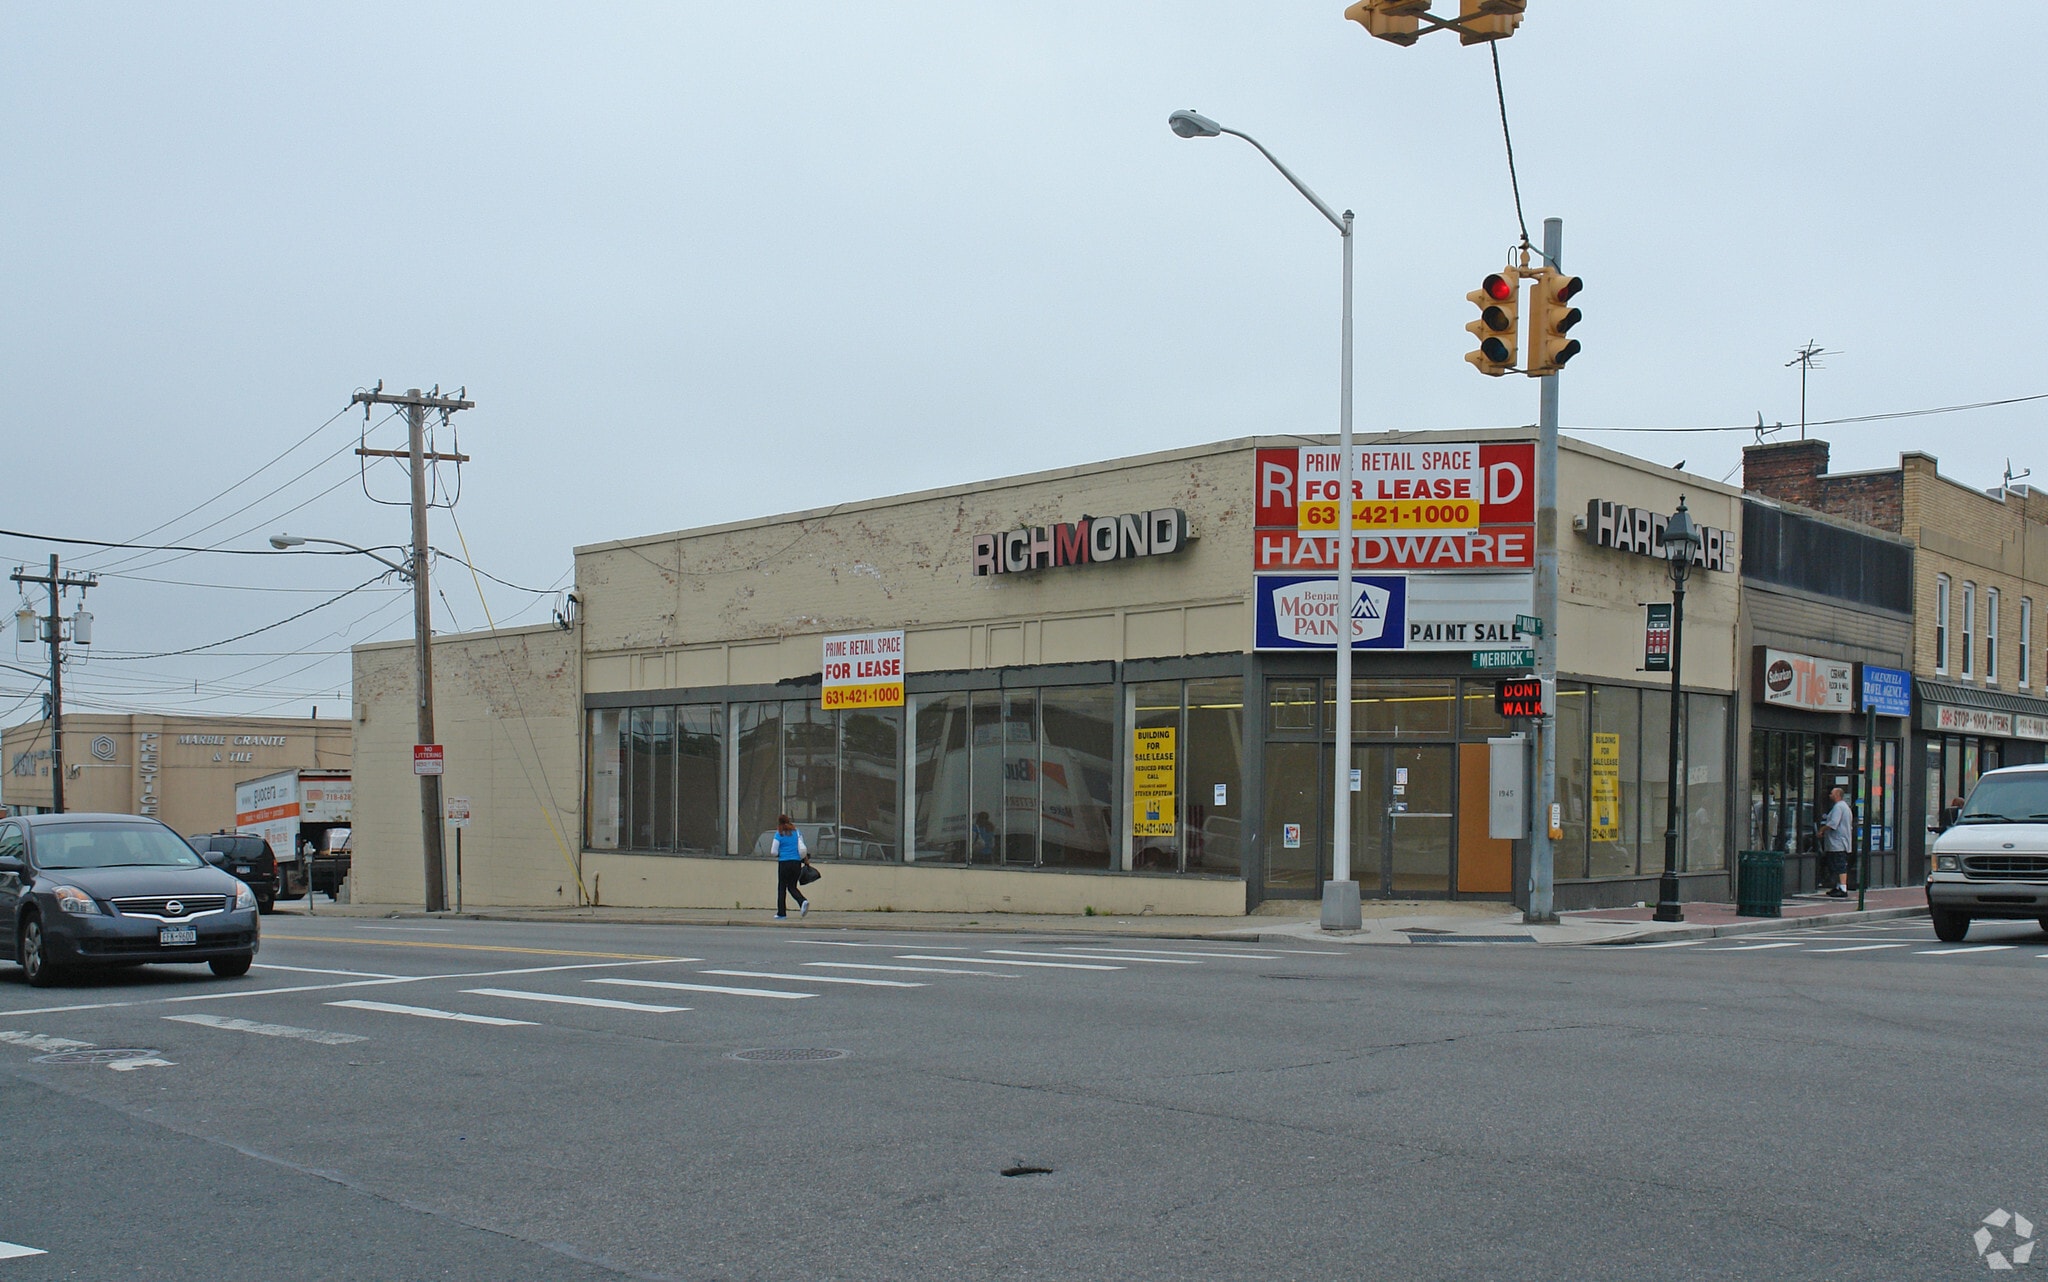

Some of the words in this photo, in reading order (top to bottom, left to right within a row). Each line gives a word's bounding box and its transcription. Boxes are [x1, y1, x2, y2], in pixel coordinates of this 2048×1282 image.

[1306, 453, 1354, 472] PRIM
[1362, 452, 1415, 471] RETAIL
[1422, 451, 1471, 470] SPACE
[1306, 480, 1363, 500] FOR
[1378, 478, 1470, 499] LEASE
[1307, 505, 1470, 525] 63-421-1000
[973, 508, 1182, 576] RICHMOND
[1596, 499, 1735, 573] HARDARE
[1281, 597, 1340, 616] Moor
[1295, 618, 1364, 636] PAINS
[1410, 624, 1467, 640] PAINT
[1475, 623, 1521, 640] SALE
[826, 641, 847, 657] PRIME
[850, 640, 875, 656] RETAIL
[878, 636, 900, 653] SPACE
[1472, 653, 1478, 661] E
[1480, 651, 1523, 667] MERRICK
[826, 663, 850, 680] FOR
[858, 658, 900, 678] LEASE
[1769, 668, 1792, 684] Suburban
[1504, 683, 1541, 698] DONT
[1792, 658, 1828, 706] Tile
[826, 686, 900, 705] 631-421-1000
[1504, 702, 1543, 716] WALK
[1954, 710, 1969, 728] STOP
[1993, 715, 2008, 732] ITEMS
[178, 735, 226, 746] MARBLE
[234, 736, 286, 746] GRANITE
[1138, 731, 1170, 740] BUILDING
[1596, 736, 1616, 744] BUILDING
[213, 752, 221, 762] &
[230, 752, 252, 762] TILE
[140, 732, 158, 815] PRESTIGE
